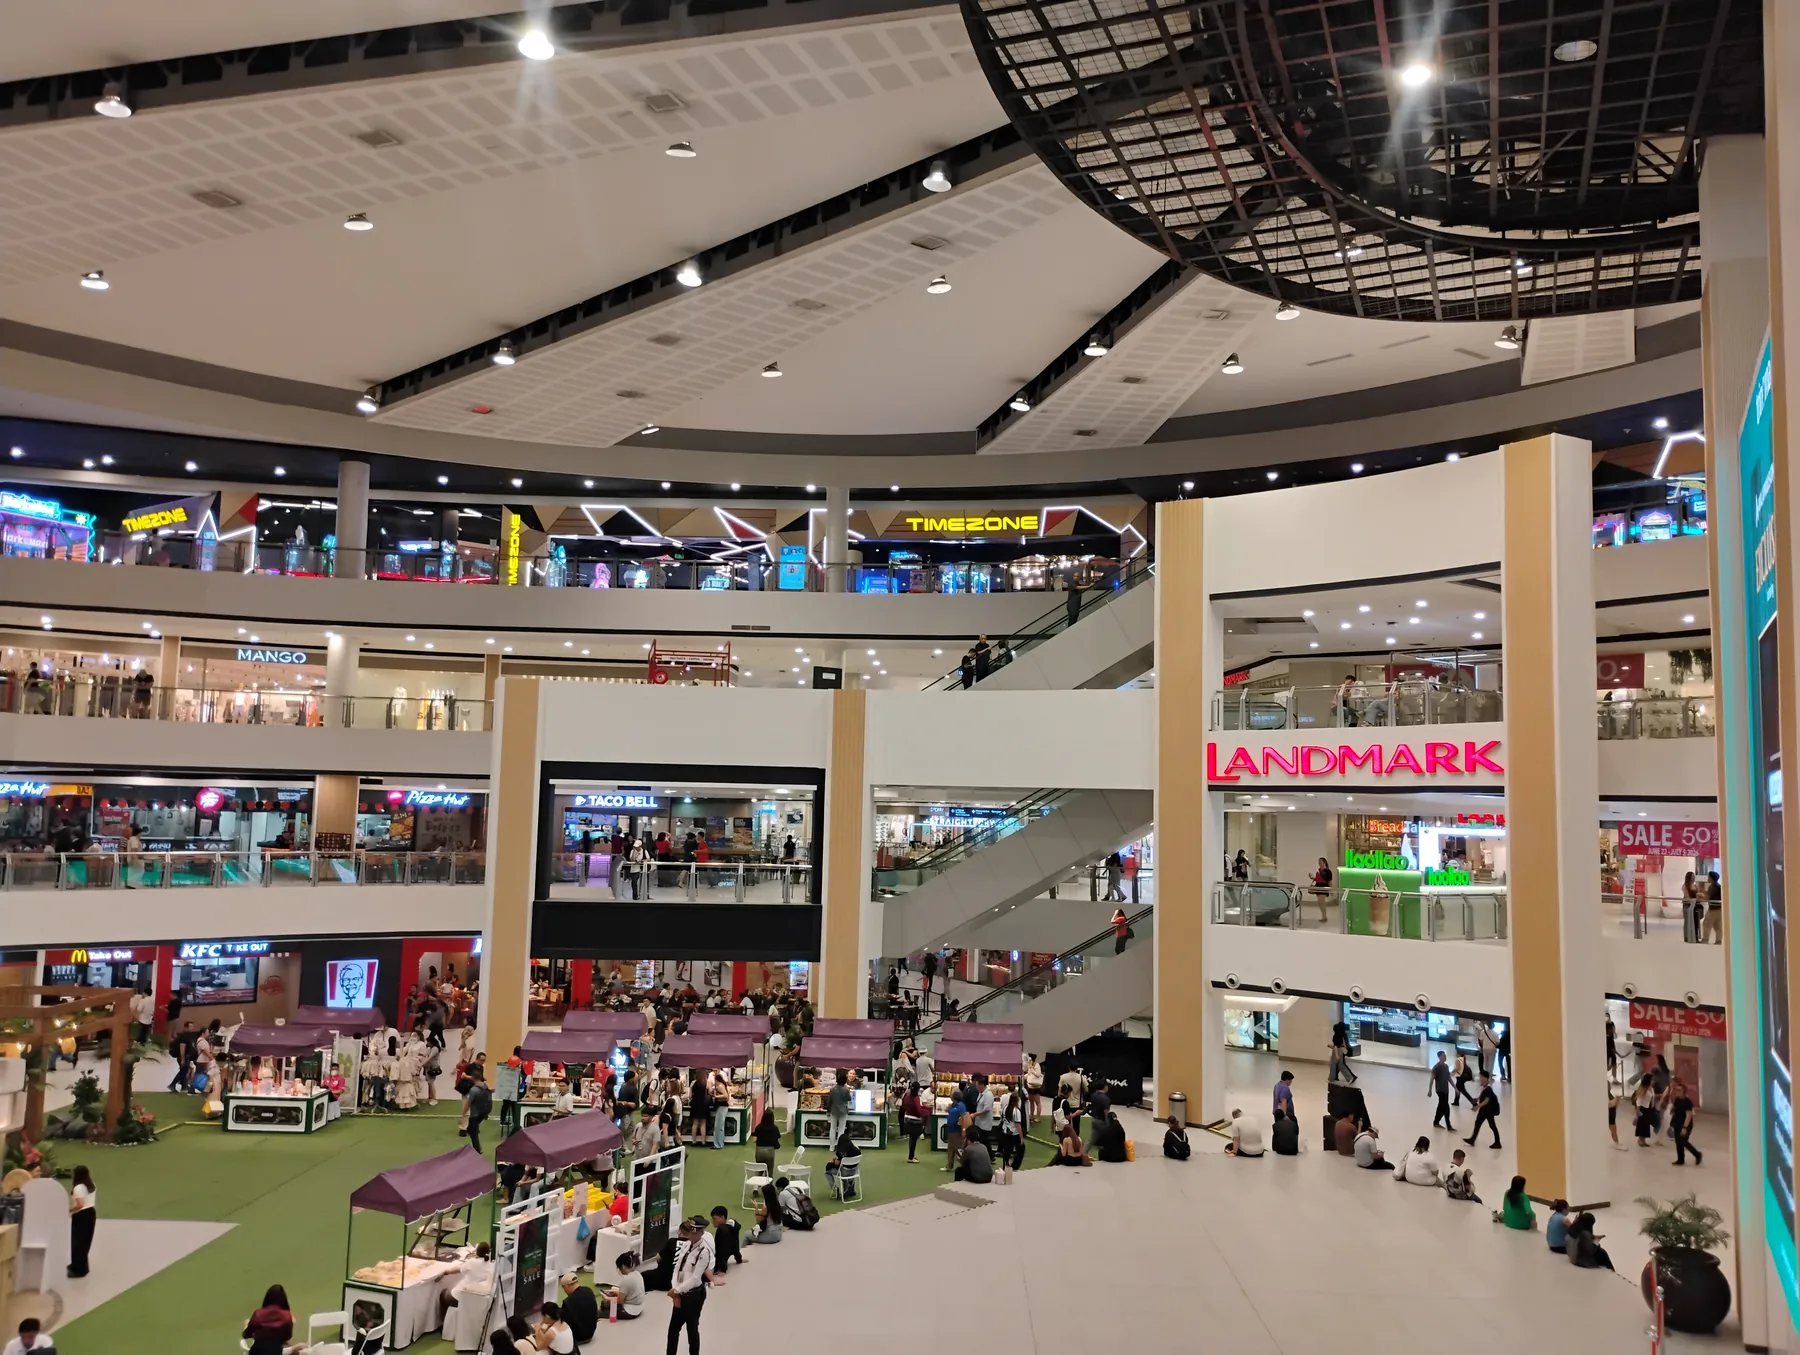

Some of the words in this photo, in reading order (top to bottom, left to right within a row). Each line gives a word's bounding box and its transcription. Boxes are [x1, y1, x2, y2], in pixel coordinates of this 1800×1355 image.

[122, 507, 188, 533] TIMEZONE
[906, 515, 1039, 532] TIMEZONE
[508, 514, 521, 586] IMEZONE
[237, 648, 307, 664] MANGO
[1207, 740, 1505, 781] LANDMARK
[20, 780, 50, 795] Hut
[406, 790, 443, 804] Pizza
[443, 793, 471, 806] Hut
[588, 795, 624, 807] TACO
[625, 796, 658, 808] BELL
[1622, 823, 1673, 847] SALE
[89, 951, 112, 960] Take
[113, 950, 132, 959] Out
[181, 944, 222, 958] KFC
[250, 942, 269, 951] OUT
[1633, 1003, 1686, 1024] SALE
[523, 1270, 541, 1285] SALE
